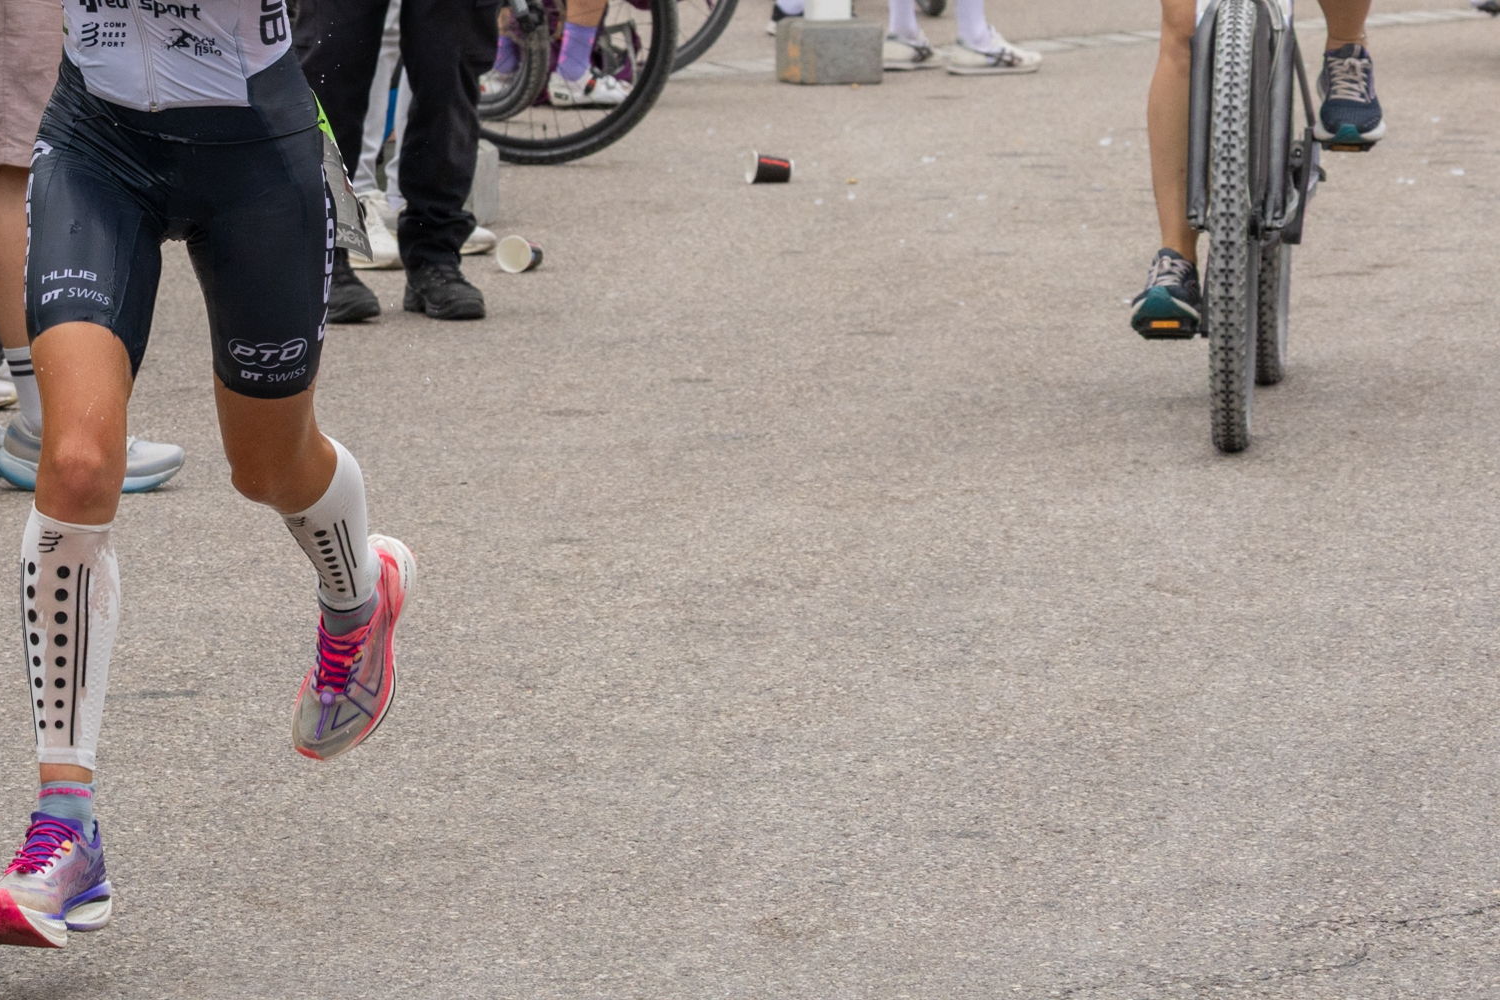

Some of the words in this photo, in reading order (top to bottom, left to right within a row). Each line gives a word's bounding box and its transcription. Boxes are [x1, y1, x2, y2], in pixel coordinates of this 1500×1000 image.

[101, 40, 125, 48] PORT
[41, 268, 98, 285] HUUB
[41, 287, 64, 306] DT
[67, 286, 111, 307] SWISS
[232, 342, 304, 362] PTO
[240, 369, 263, 381] DT
[266, 363, 308, 383] SWISS
